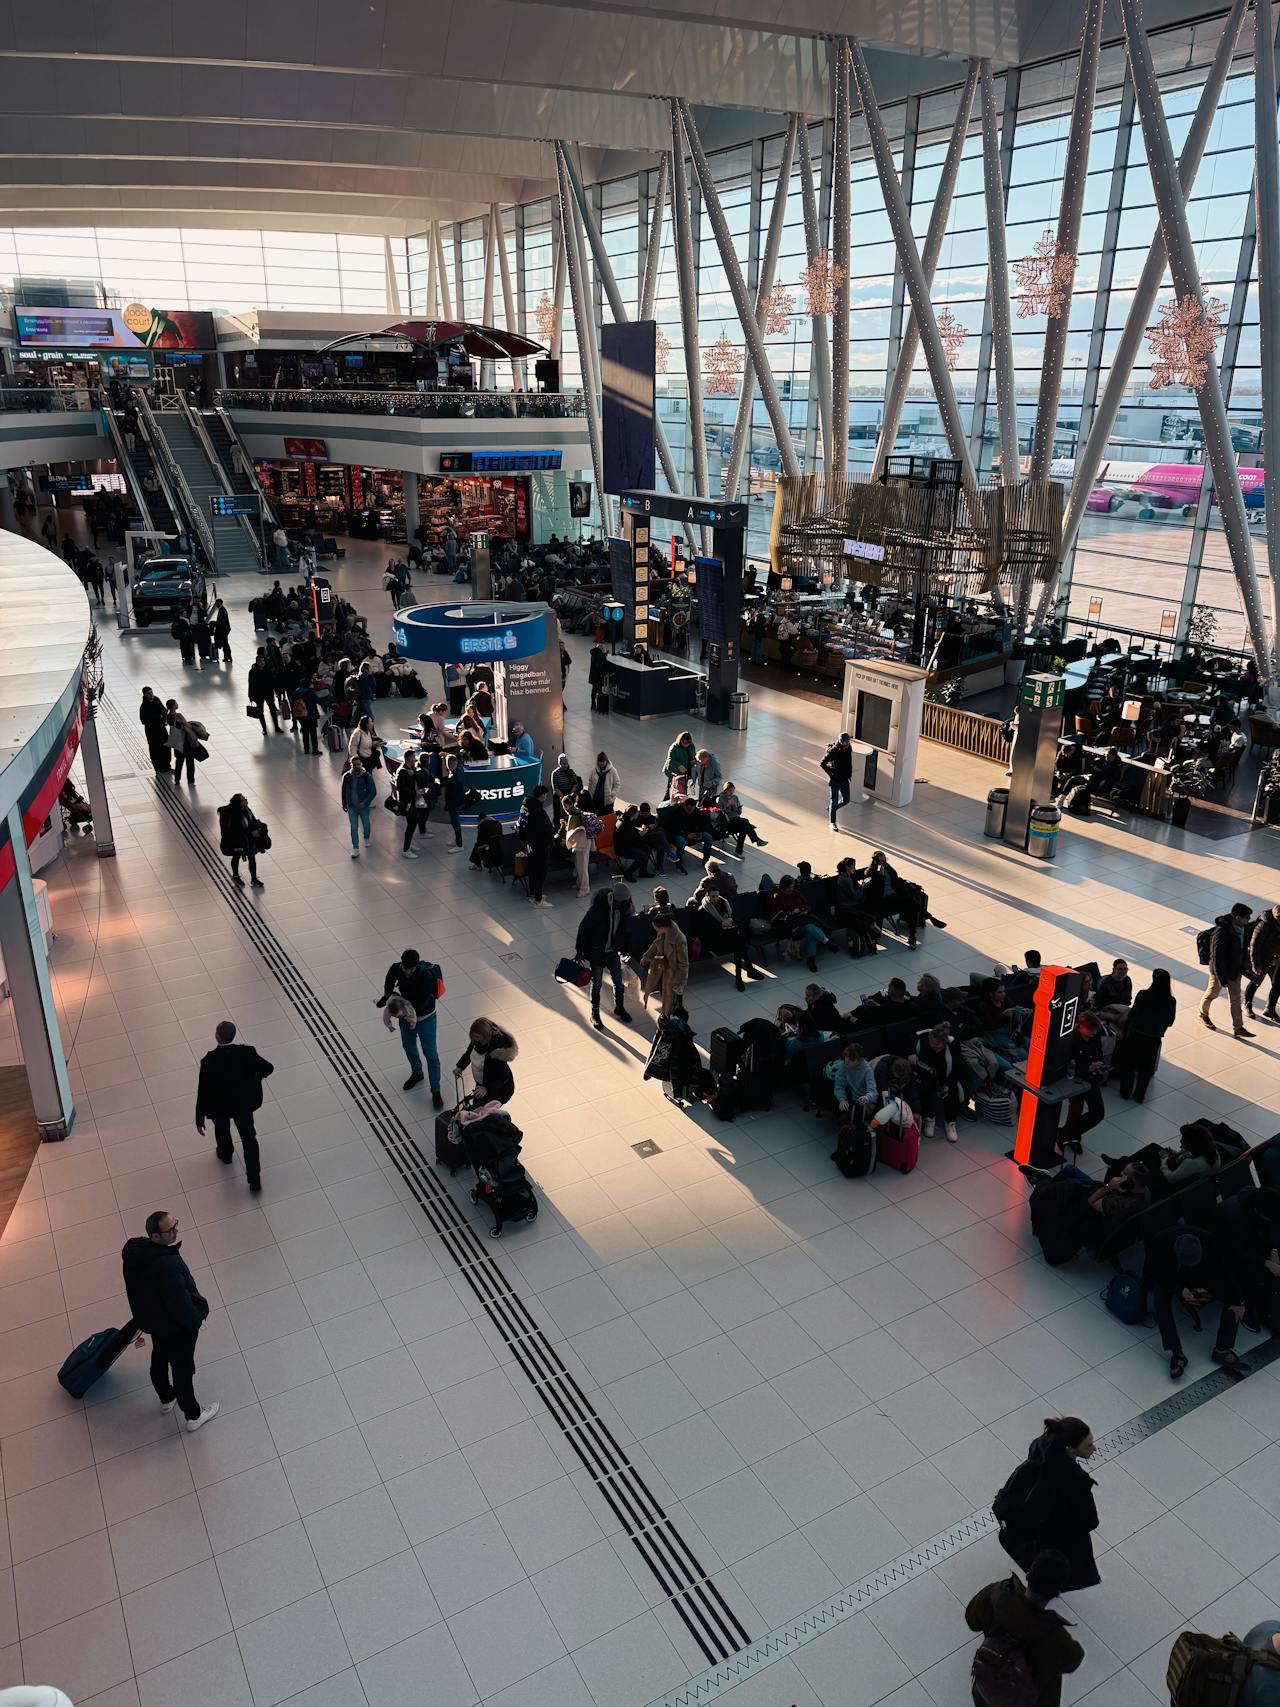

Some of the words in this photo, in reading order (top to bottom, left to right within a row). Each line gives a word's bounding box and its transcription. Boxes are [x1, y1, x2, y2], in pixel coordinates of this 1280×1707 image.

[127, 307, 147, 317] food
[127, 317, 150, 326] court
[19, 350, 37, 359] soul
[42, 352, 64, 361] grain
[645, 499, 651, 511] B
[687, 506, 694, 518] A
[461, 638, 503, 653] ERSTE
[509, 664, 529, 672] Higgy
[510, 670, 546, 680] magadban!
[538, 677, 551, 685] már
[510, 688, 524, 696] hisz
[525, 686, 552, 695] benned.
[476, 787, 511, 800] RSTE
